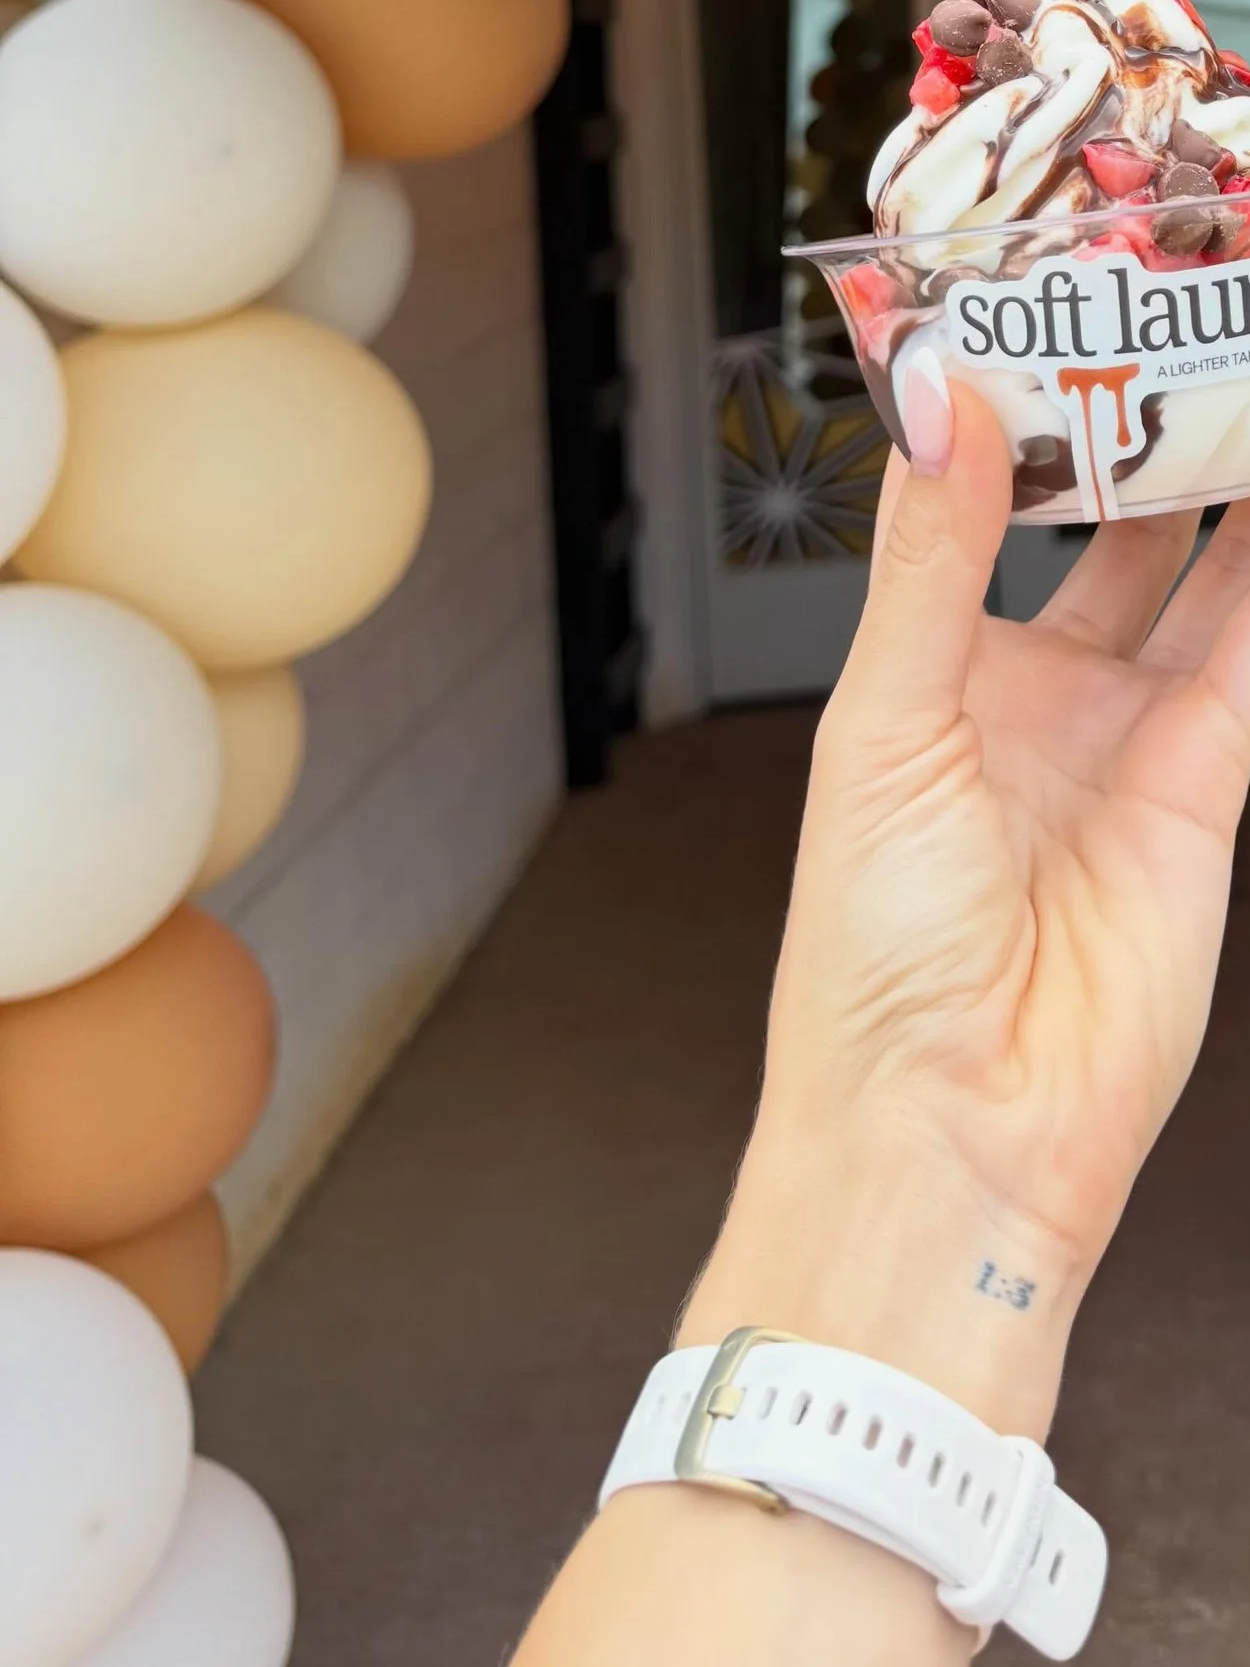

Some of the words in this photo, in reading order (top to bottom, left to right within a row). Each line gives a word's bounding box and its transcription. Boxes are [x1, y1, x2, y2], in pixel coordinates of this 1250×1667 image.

[960, 271, 1097, 357] soft
[1157, 365, 1168, 379] A
[1170, 355, 1229, 377] LIGHTER
